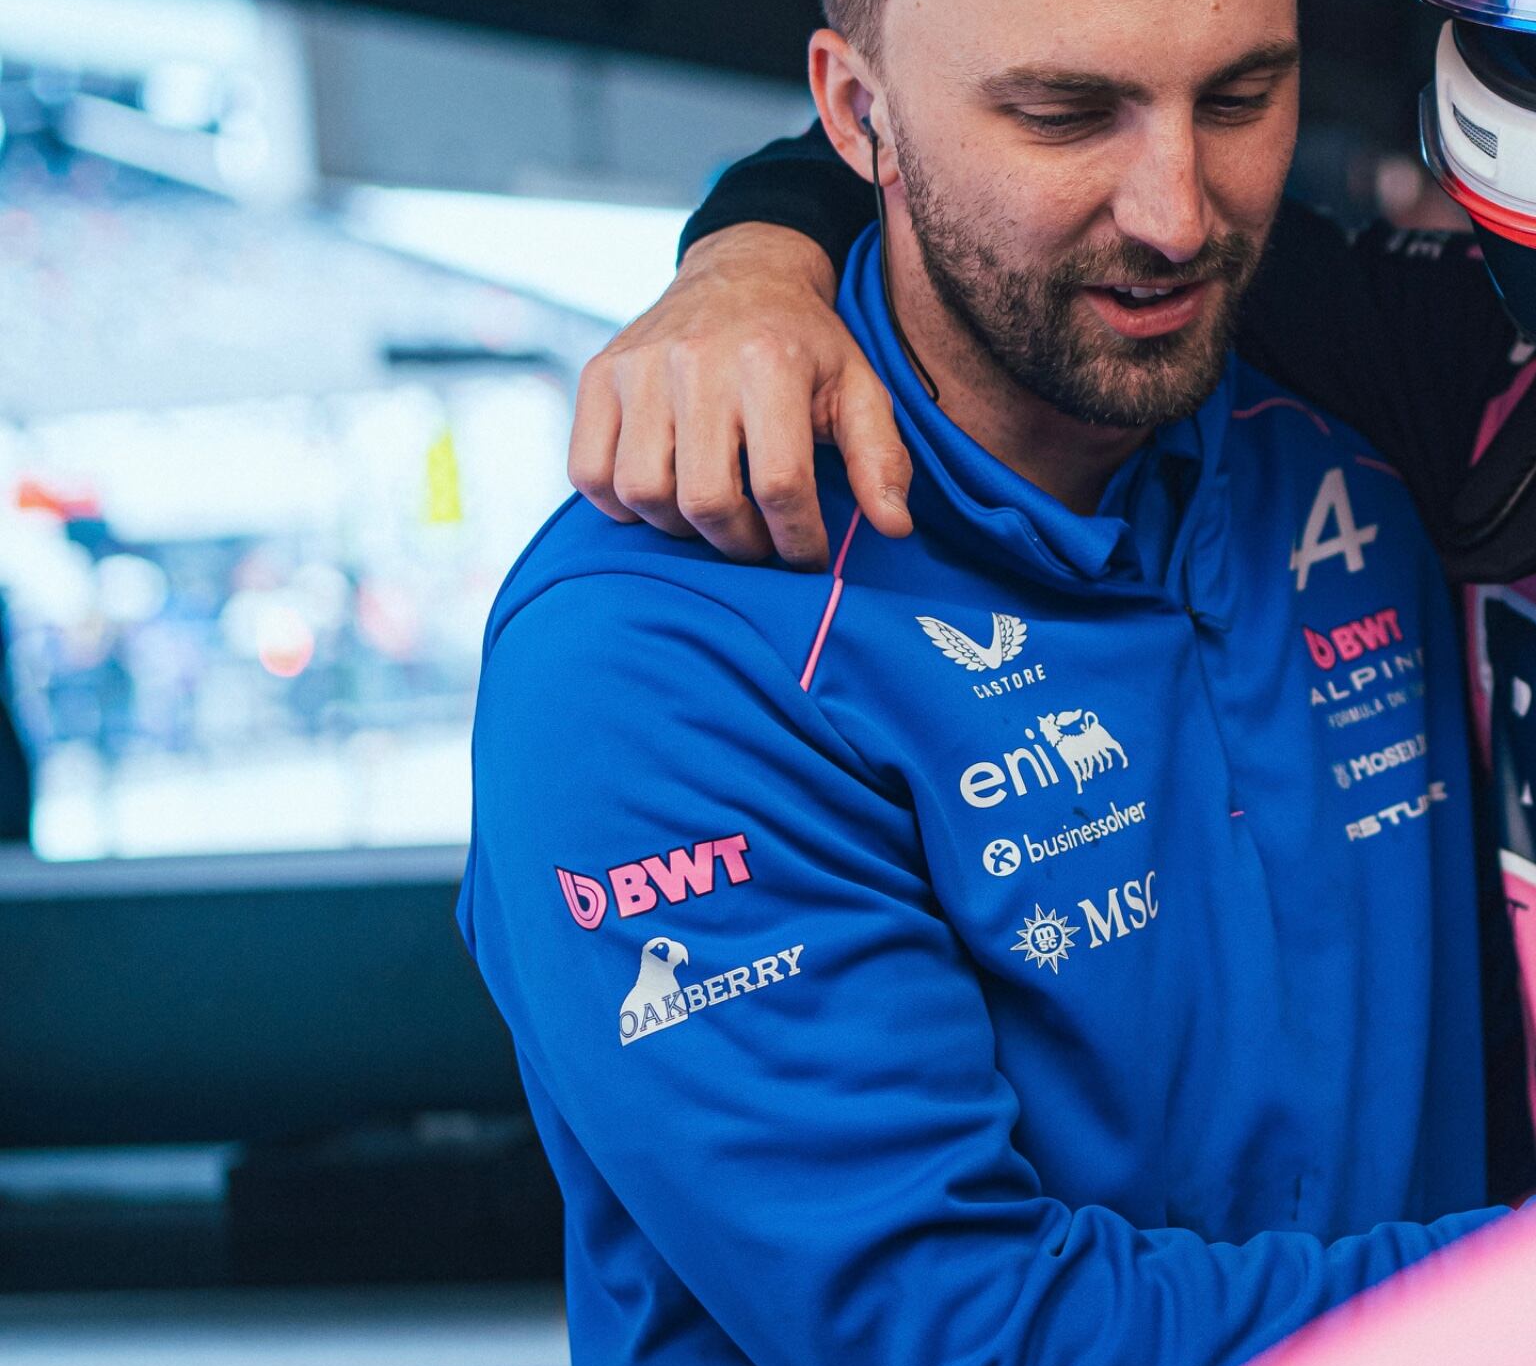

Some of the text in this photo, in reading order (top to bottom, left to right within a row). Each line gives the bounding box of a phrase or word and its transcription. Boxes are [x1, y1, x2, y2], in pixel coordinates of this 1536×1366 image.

[1330, 607, 1404, 662] BWT
[972, 663, 1046, 699] CASTORE
[959, 727, 1060, 809] eni
[1024, 800, 1147, 864] businessolver
[606, 833, 753, 920] BWT
[1077, 870, 1159, 950] MSC
[619, 944, 804, 1039] OAKBERRY
